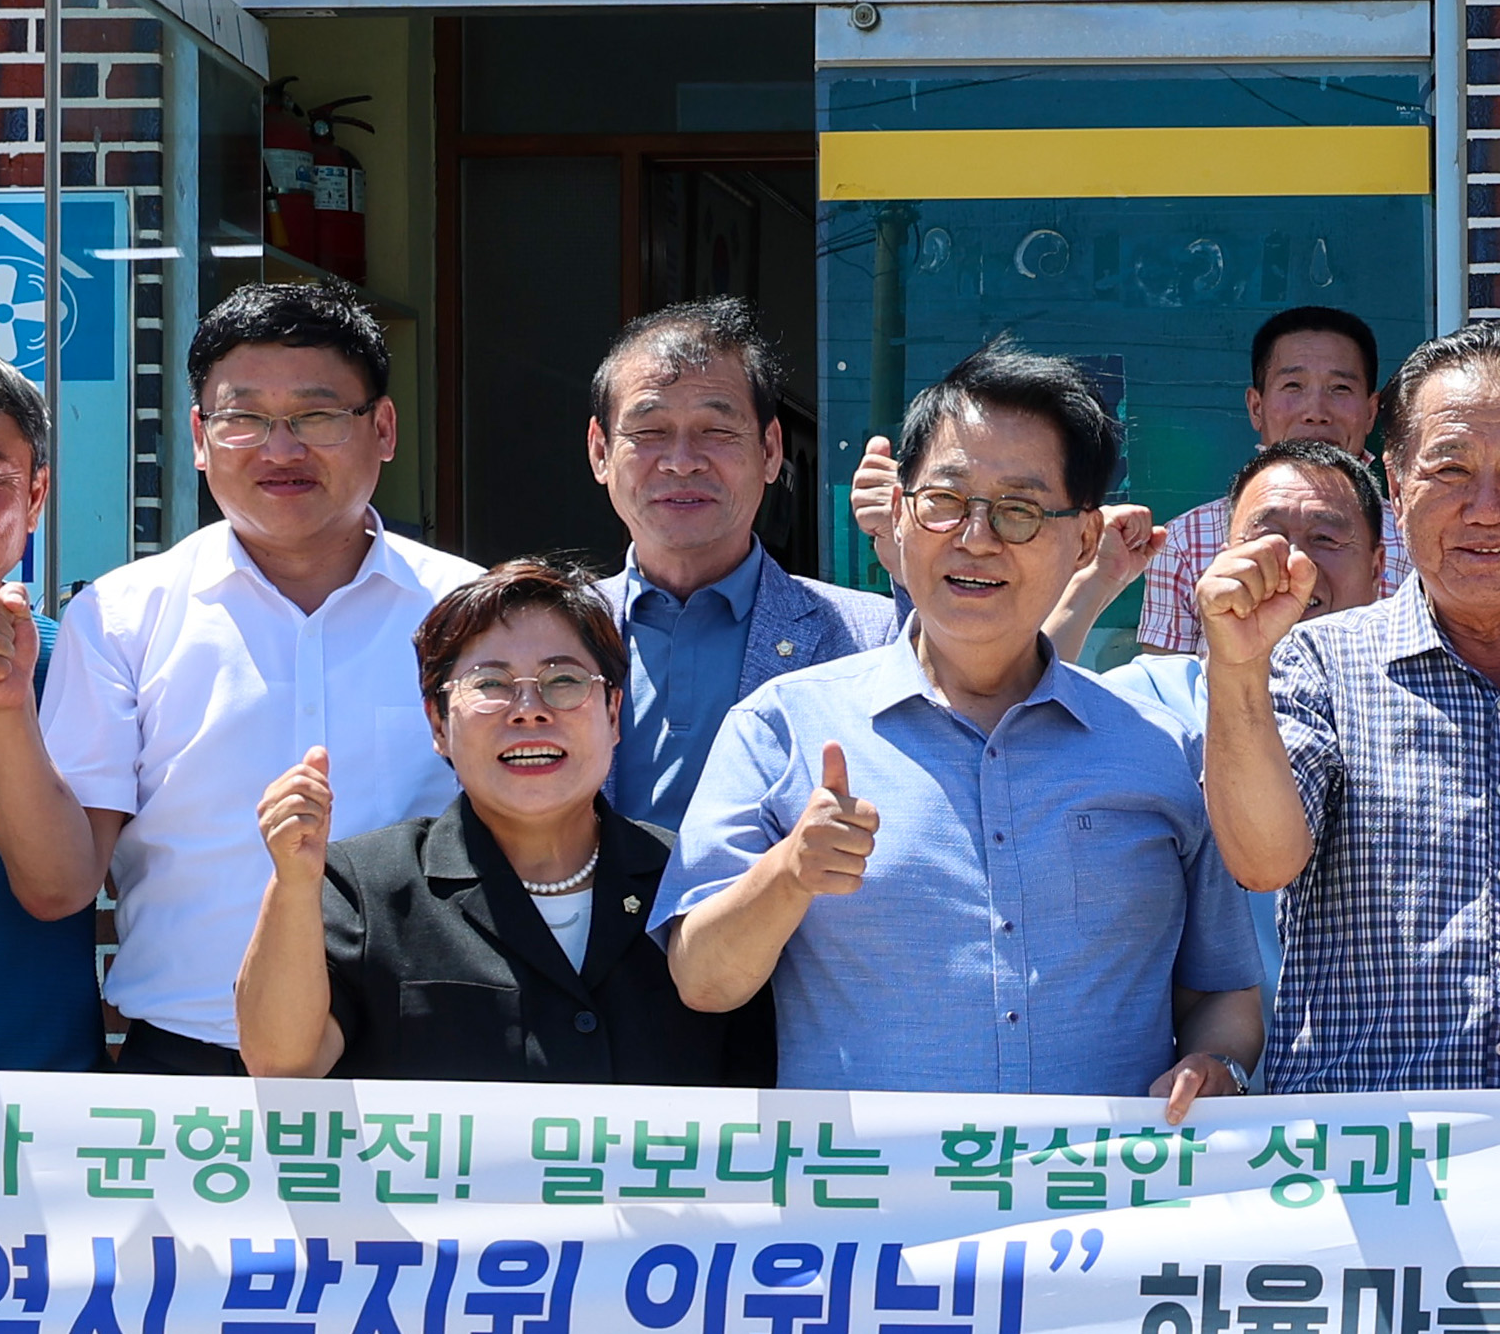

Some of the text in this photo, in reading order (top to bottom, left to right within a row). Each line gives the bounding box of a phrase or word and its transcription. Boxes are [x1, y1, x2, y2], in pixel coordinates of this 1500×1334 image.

[77, 1107, 473, 1204] 균형발전!
[532, 1117, 889, 1208] 말보다는
[934, 1123, 1208, 1212] 확실한
[1248, 1121, 1452, 1208] 성과!
